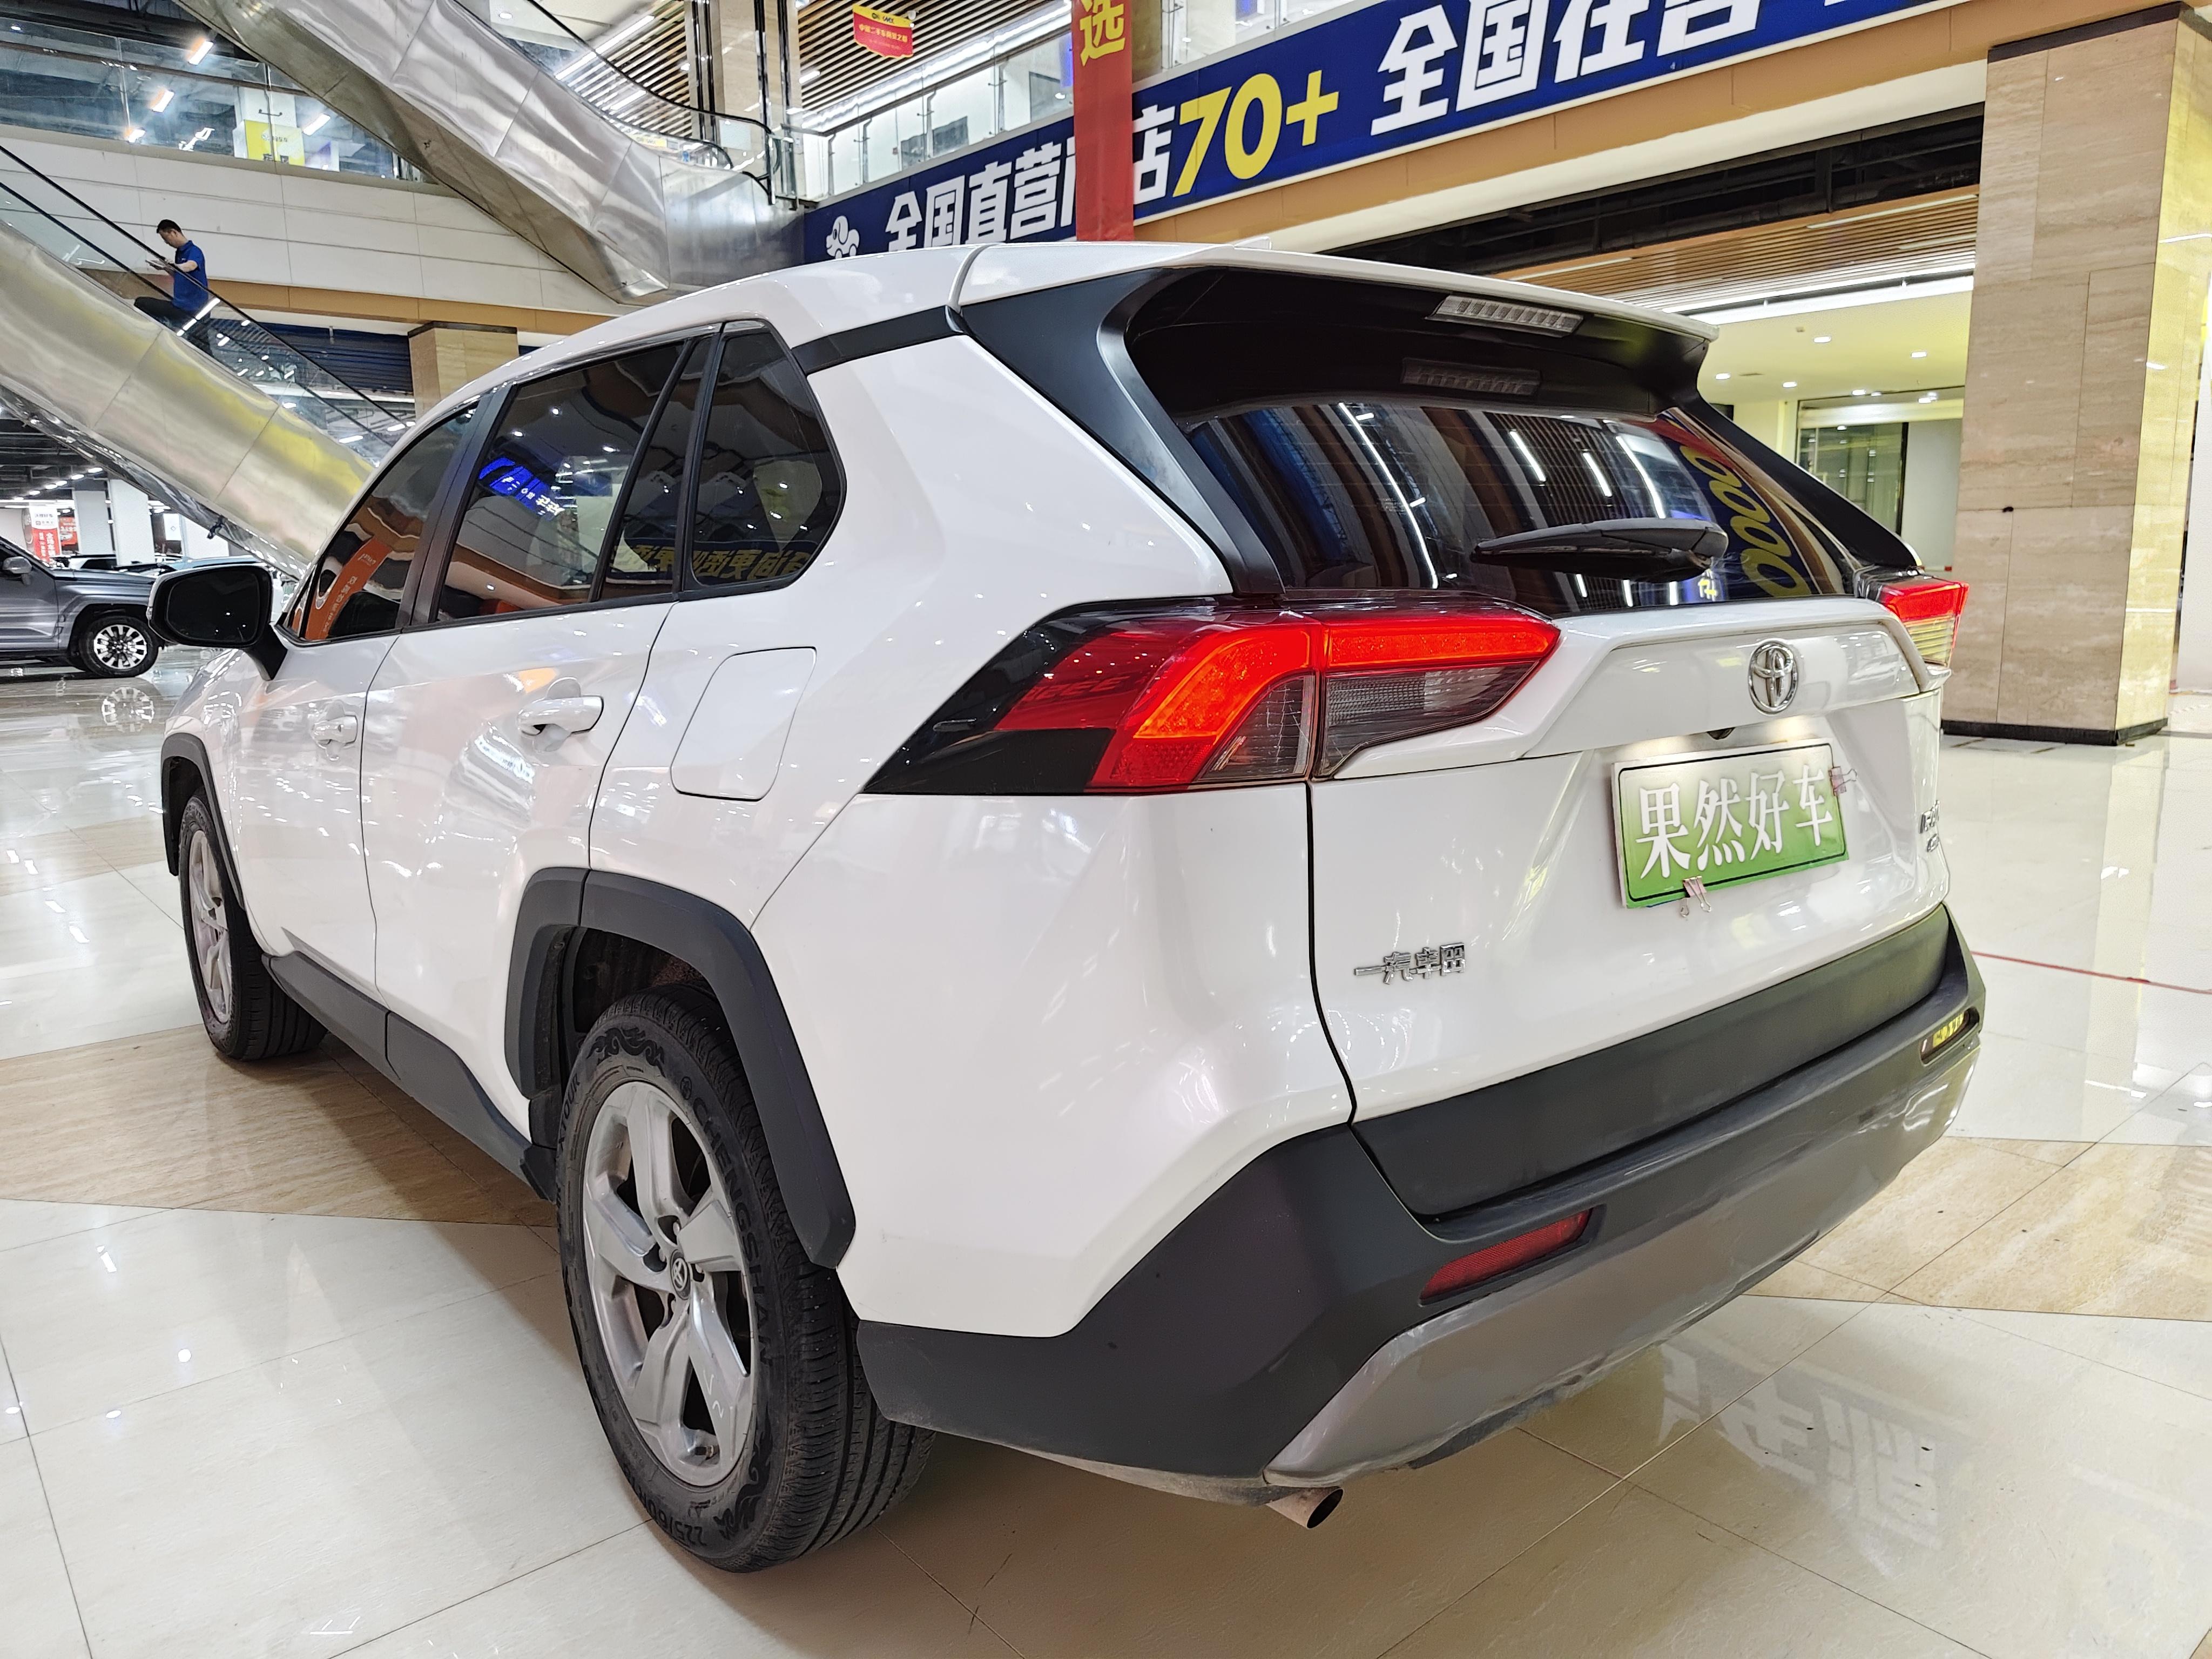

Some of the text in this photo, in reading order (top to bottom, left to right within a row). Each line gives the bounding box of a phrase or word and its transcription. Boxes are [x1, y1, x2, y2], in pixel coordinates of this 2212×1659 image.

[1080, 0, 1125, 66] 选
[1635, 764, 1833, 879] 果然好车
[1353, 942, 1466, 984] 一汽丰田
[693, 1097, 774, 1367] CHENGSHAN
